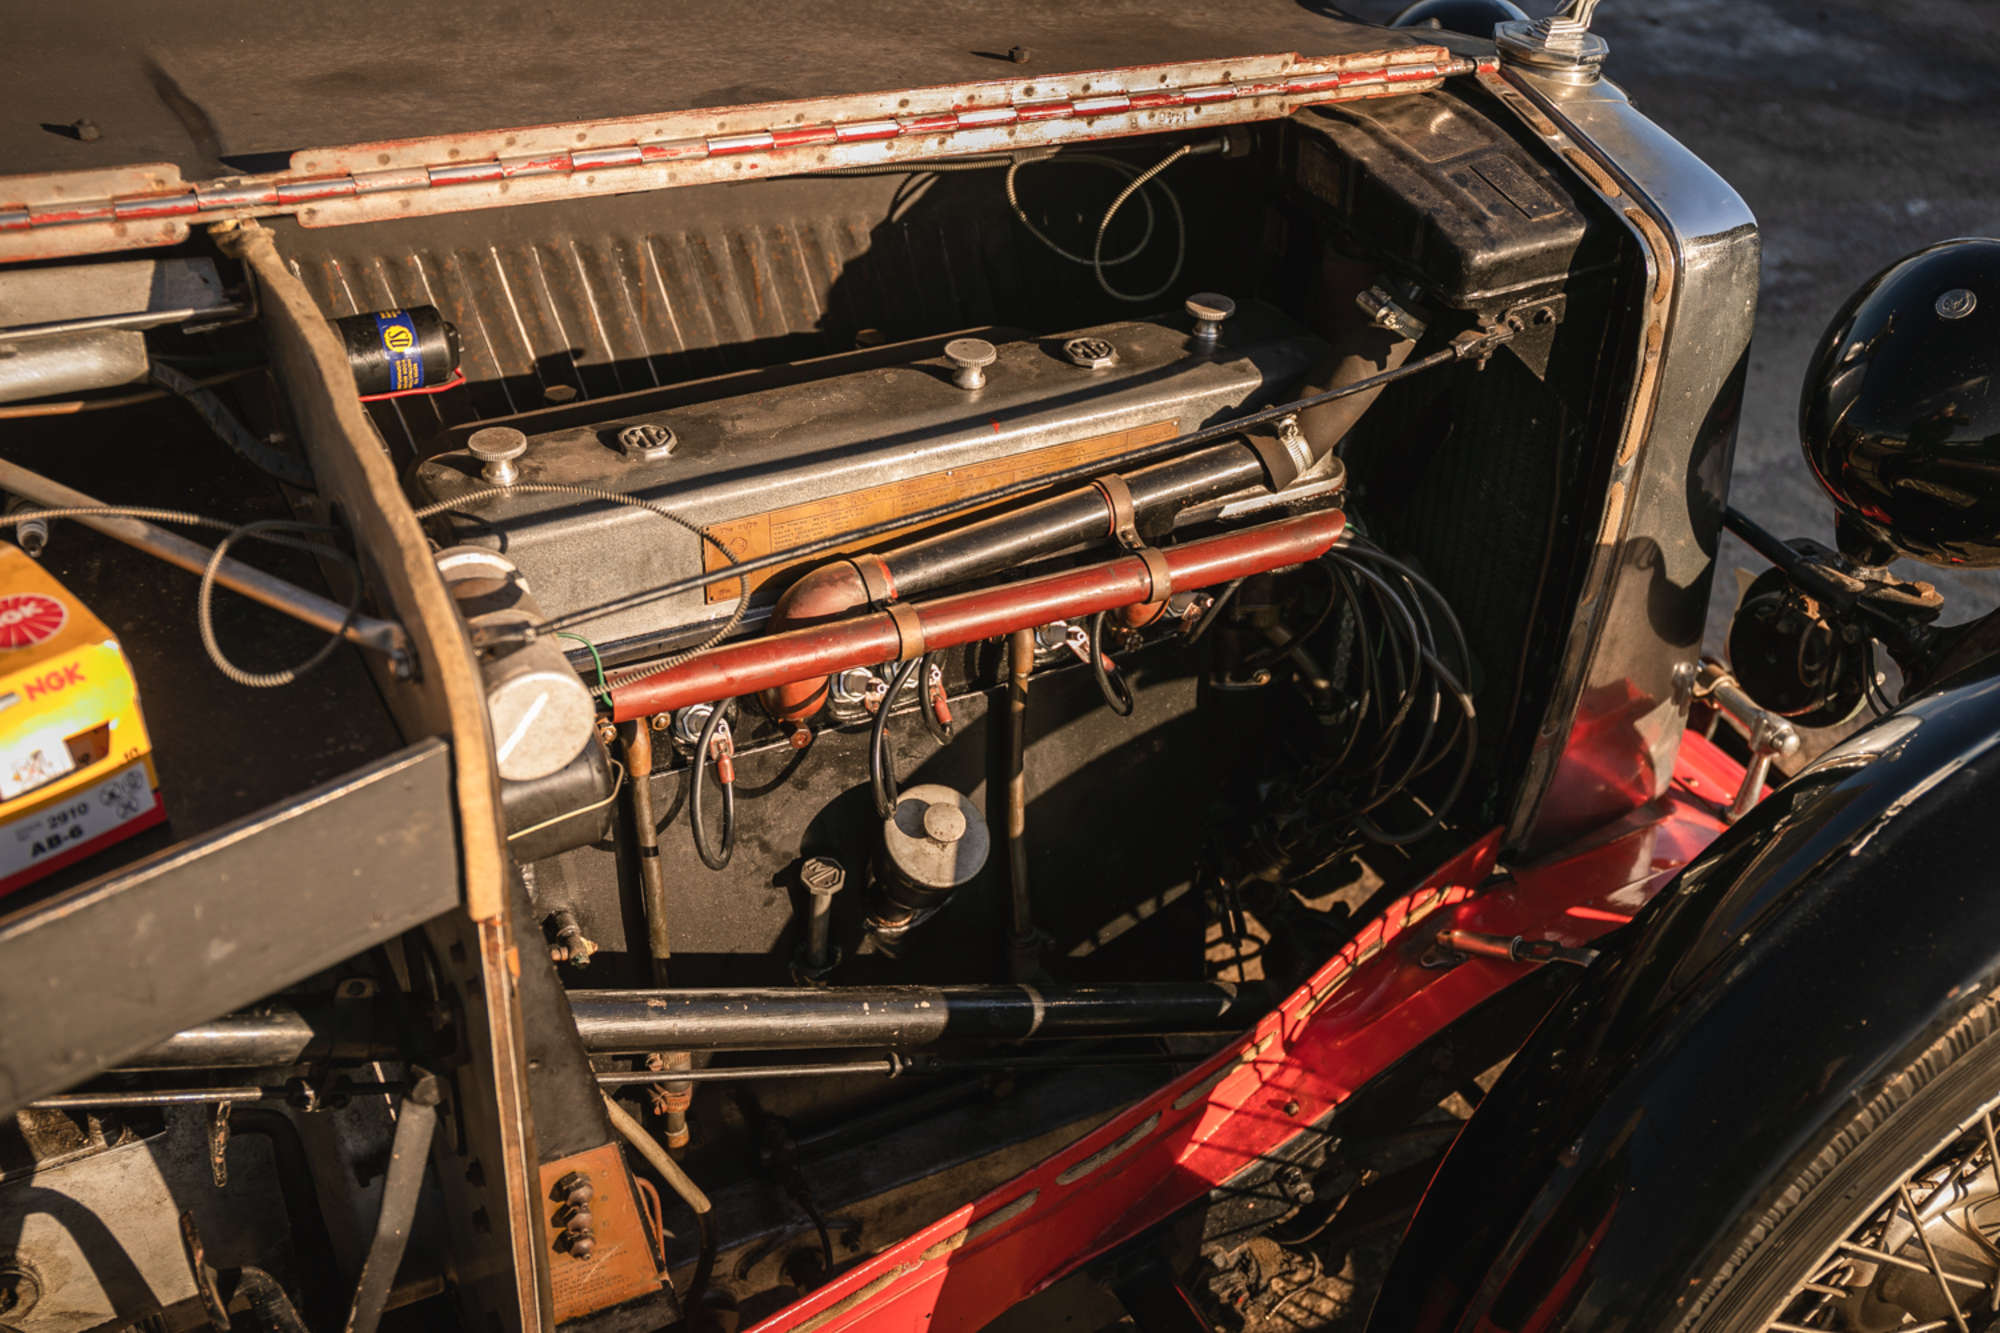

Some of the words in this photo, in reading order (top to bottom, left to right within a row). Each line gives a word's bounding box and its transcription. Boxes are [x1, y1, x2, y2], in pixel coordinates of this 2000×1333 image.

[1068, 340, 1113, 360] MG
[622, 426, 673, 449] MG
[0, 600, 45, 628] GK
[23, 661, 86, 700] NGK
[47, 801, 89, 830] 2910
[31, 824, 84, 858] AB-6
